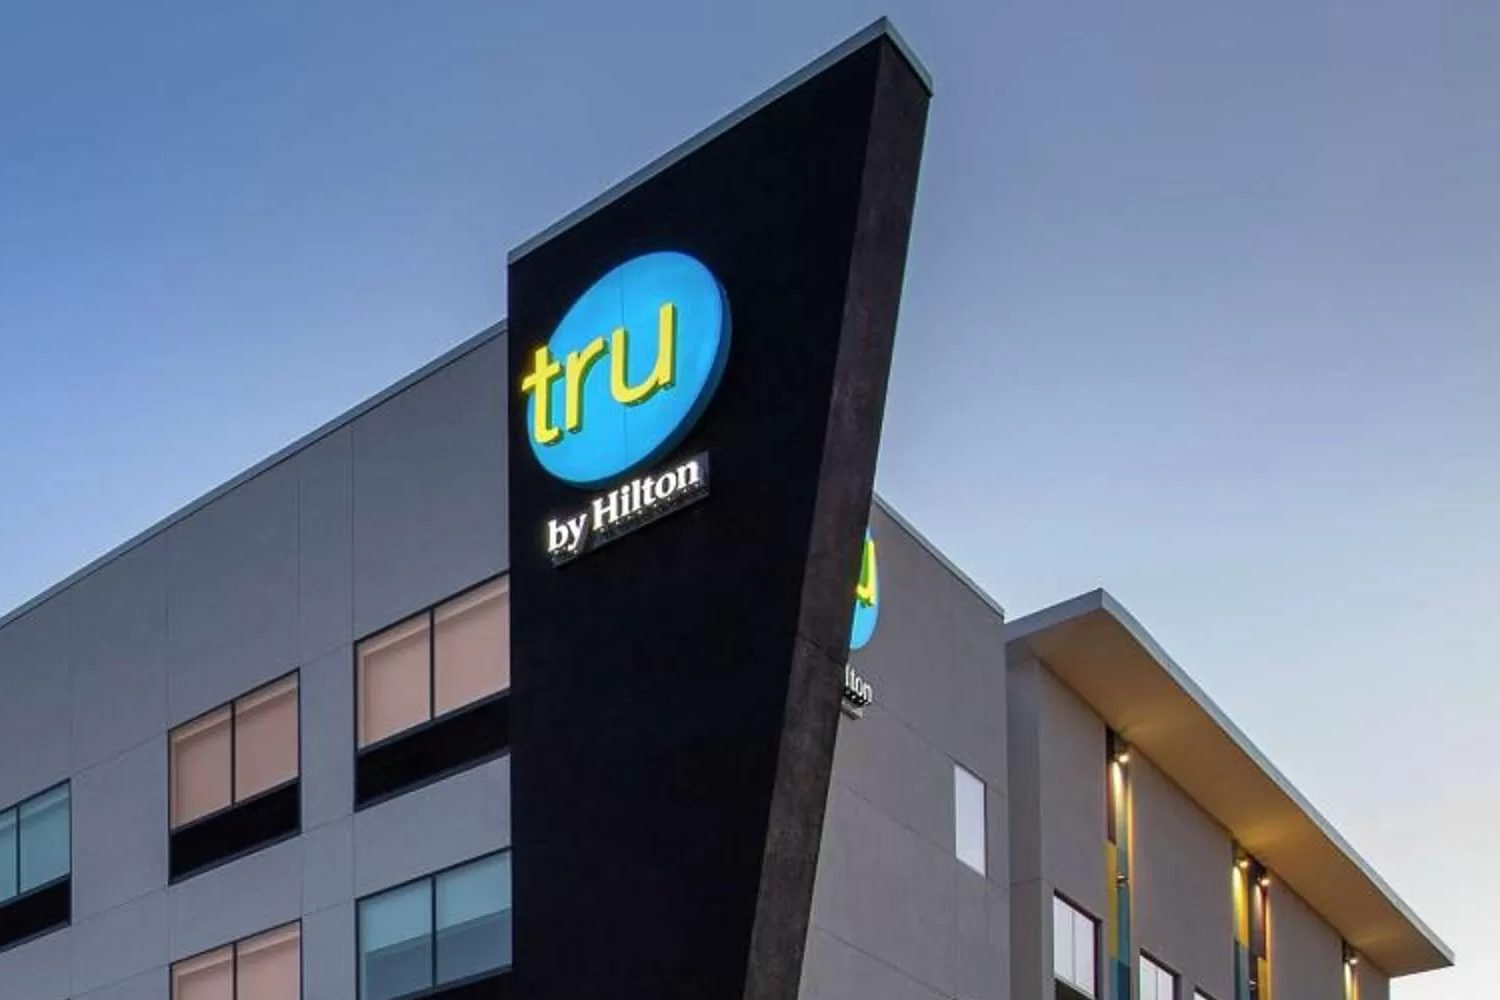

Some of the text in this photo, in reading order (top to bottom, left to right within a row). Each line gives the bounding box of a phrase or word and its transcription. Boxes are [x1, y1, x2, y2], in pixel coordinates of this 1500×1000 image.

[522, 302, 674, 445] tru
[548, 460, 700, 552] by Hilton
[845, 662, 872, 702] lton
